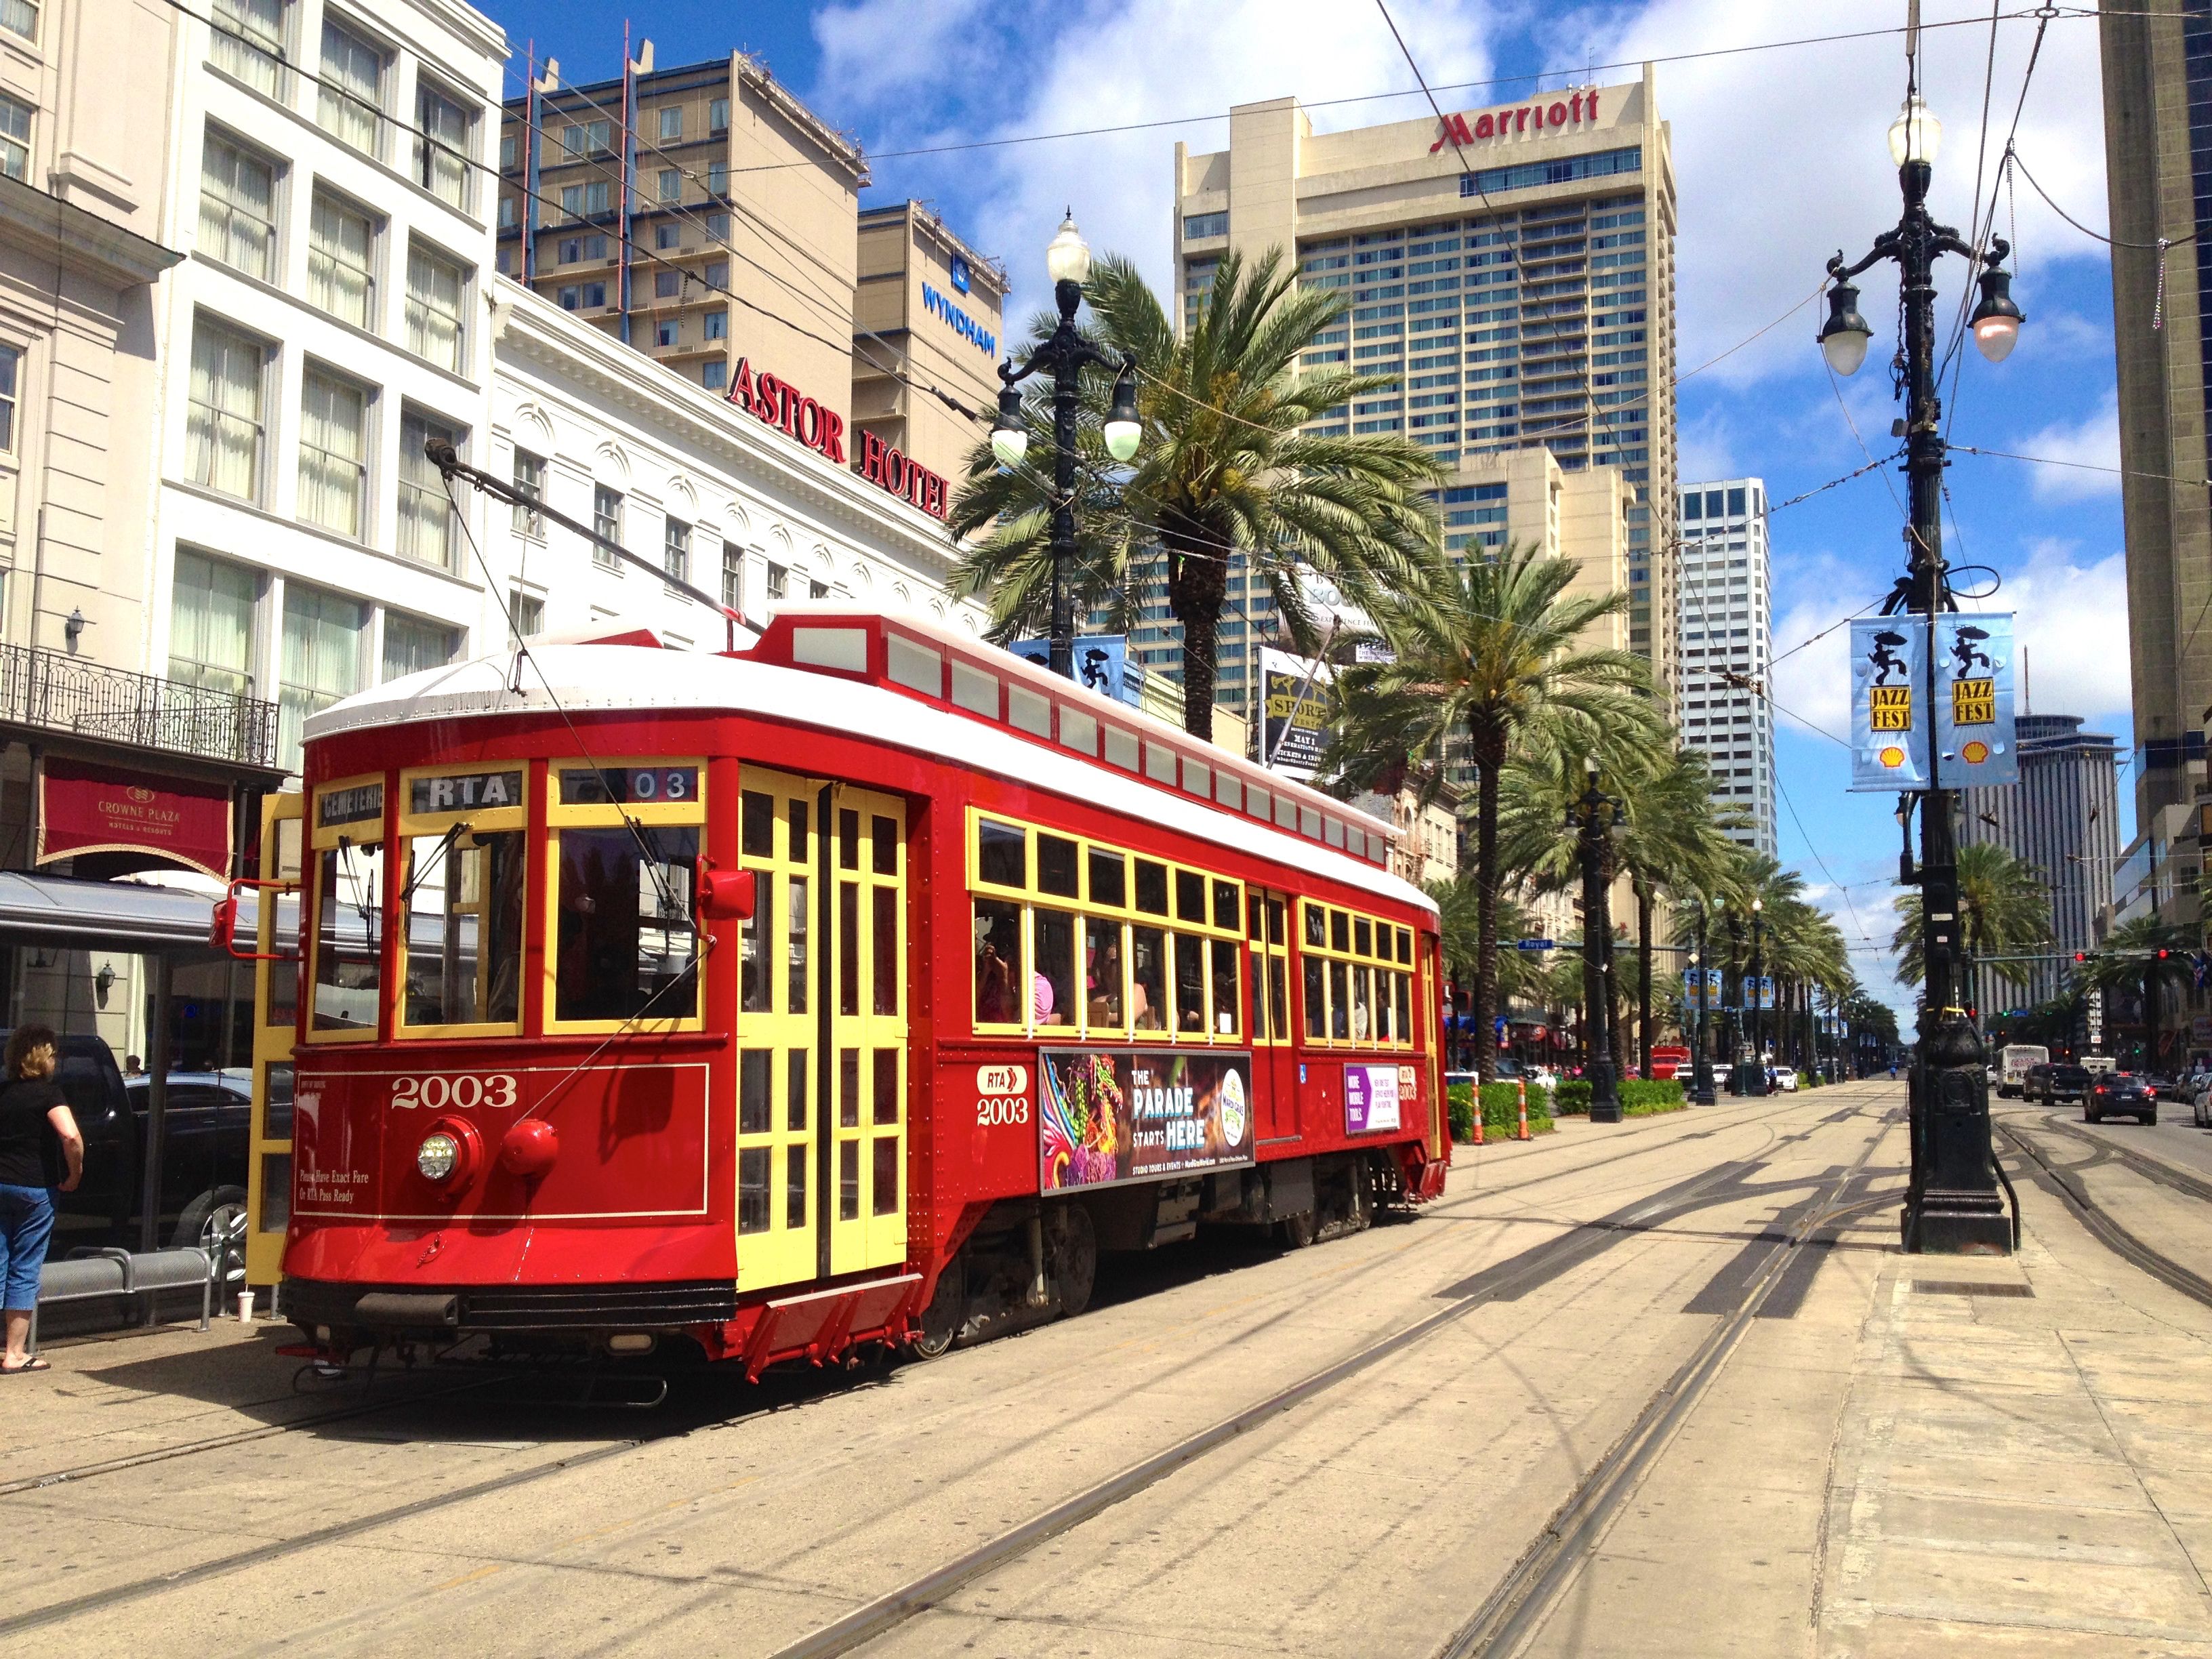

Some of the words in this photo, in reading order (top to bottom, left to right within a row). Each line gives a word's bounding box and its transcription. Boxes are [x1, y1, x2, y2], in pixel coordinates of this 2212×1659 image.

[1429, 89, 1599, 152] Marriott
[922, 281, 996, 358] WYNDHAM
[726, 357, 846, 464] ASTOR
[1872, 689, 1908, 708] JAZZ
[1955, 681, 1992, 703] JAZZ
[1872, 710, 1910, 727] FEST
[1956, 703, 1993, 722] FEST
[1294, 735, 1310, 745] MAY
[429, 775, 508, 807] RTA
[98, 801, 143, 818] CROWNE
[148, 808, 180, 823] PLAZA
[325, 786, 383, 819] CEMETERIE
[108, 822, 134, 831] HOTELS
[142, 826, 171, 836] RESORTS
[1525, 940, 1548, 949] Royal
[987, 1072, 1005, 1088] RTA
[1131, 1070, 1150, 1086] THE
[391, 1074, 517, 1109] 2003
[977, 1097, 1029, 1126] 2003
[1133, 1087, 1193, 1120] PARADE
[1132, 1130, 1164, 1148] STARTS
[1166, 1119, 1205, 1151] HERE
[316, 1170, 330, 1183] Have
[332, 1170, 350, 1183] Exact
[352, 1170, 369, 1184] Fare
[1132, 1165, 1148, 1175] STUDIO
[1149, 1163, 1162, 1173] TOURS
[1166, 1160, 1181, 1170] EVENTS
[307, 1188, 318, 1201] RTA
[319, 1188, 332, 1202] Pass
[333, 1189, 354, 1204] Ready
